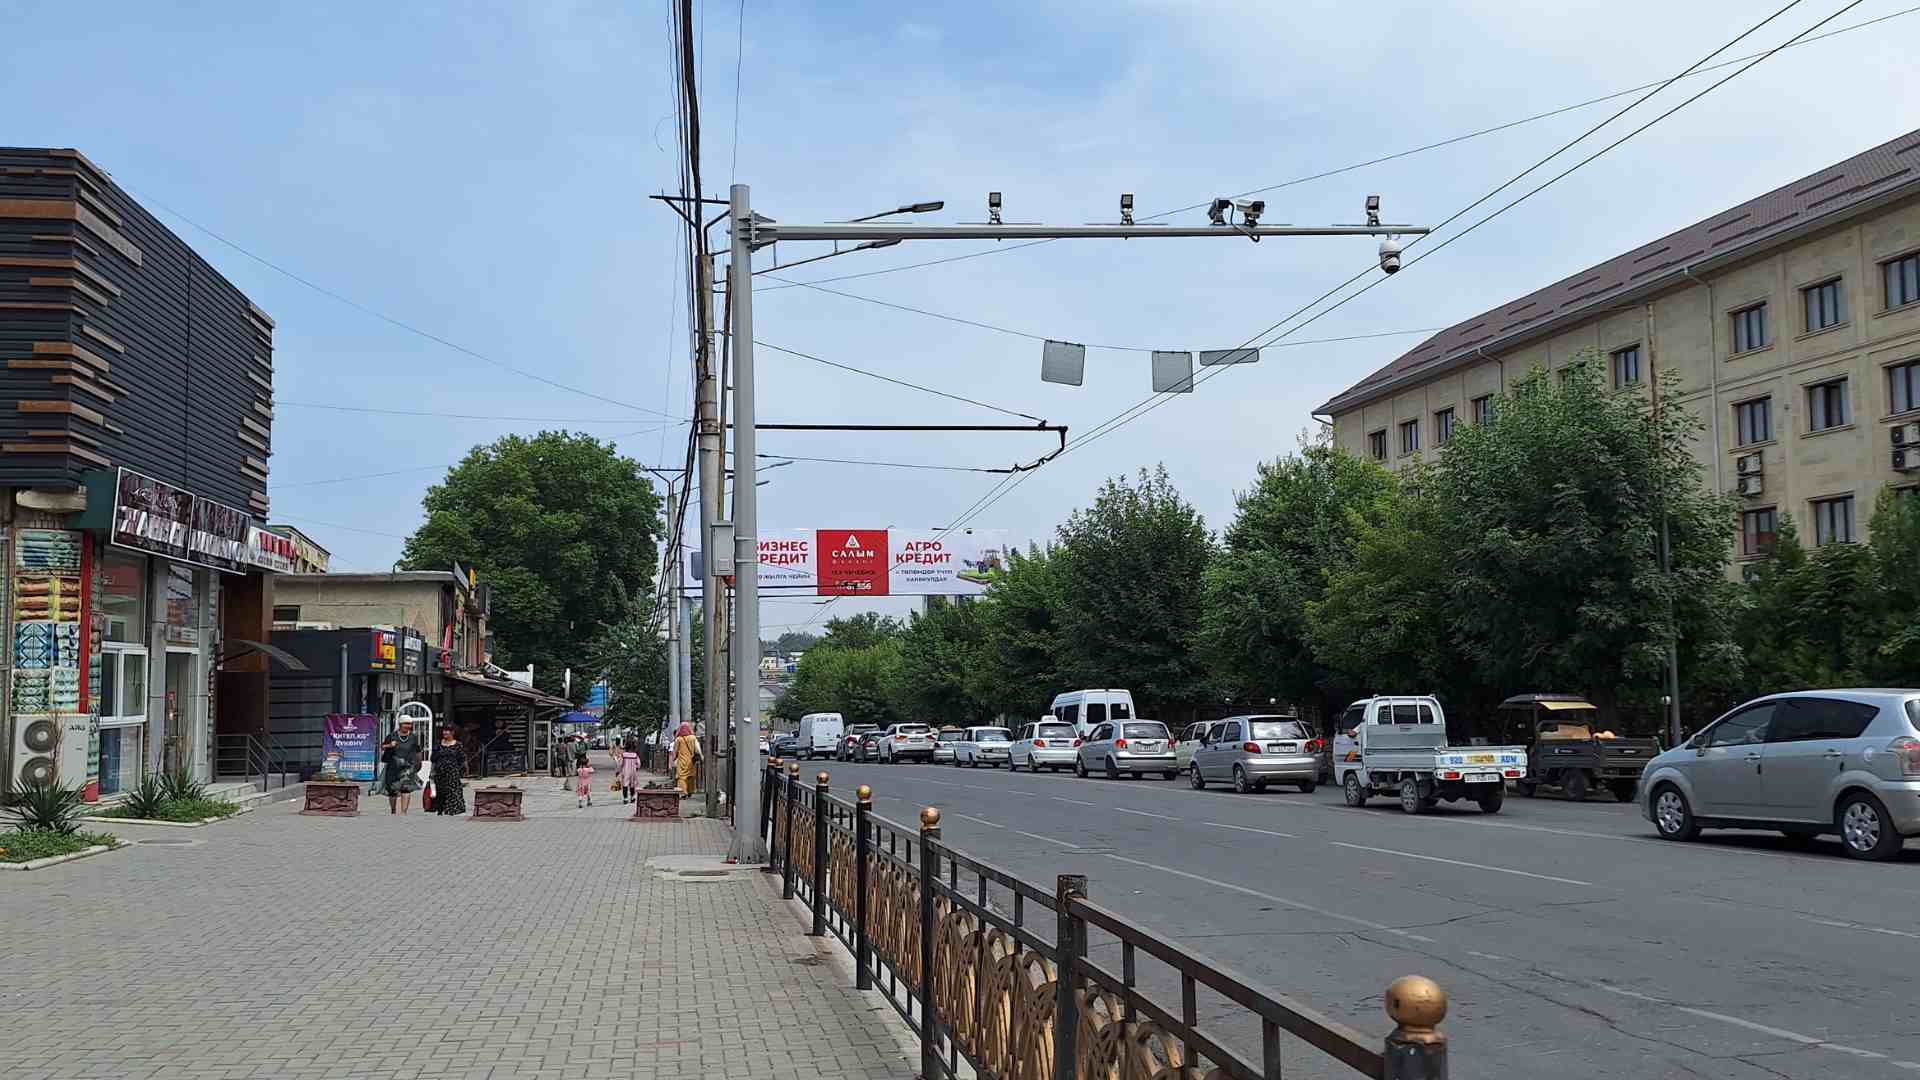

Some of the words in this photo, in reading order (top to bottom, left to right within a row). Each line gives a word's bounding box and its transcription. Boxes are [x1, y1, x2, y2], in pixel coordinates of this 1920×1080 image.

[757, 541, 808, 551] ИЗНЕС
[905, 541, 942, 551] АГРО
[757, 553, 808, 565] РЕДИТ
[896, 553, 952, 565] КРЕДИТ
